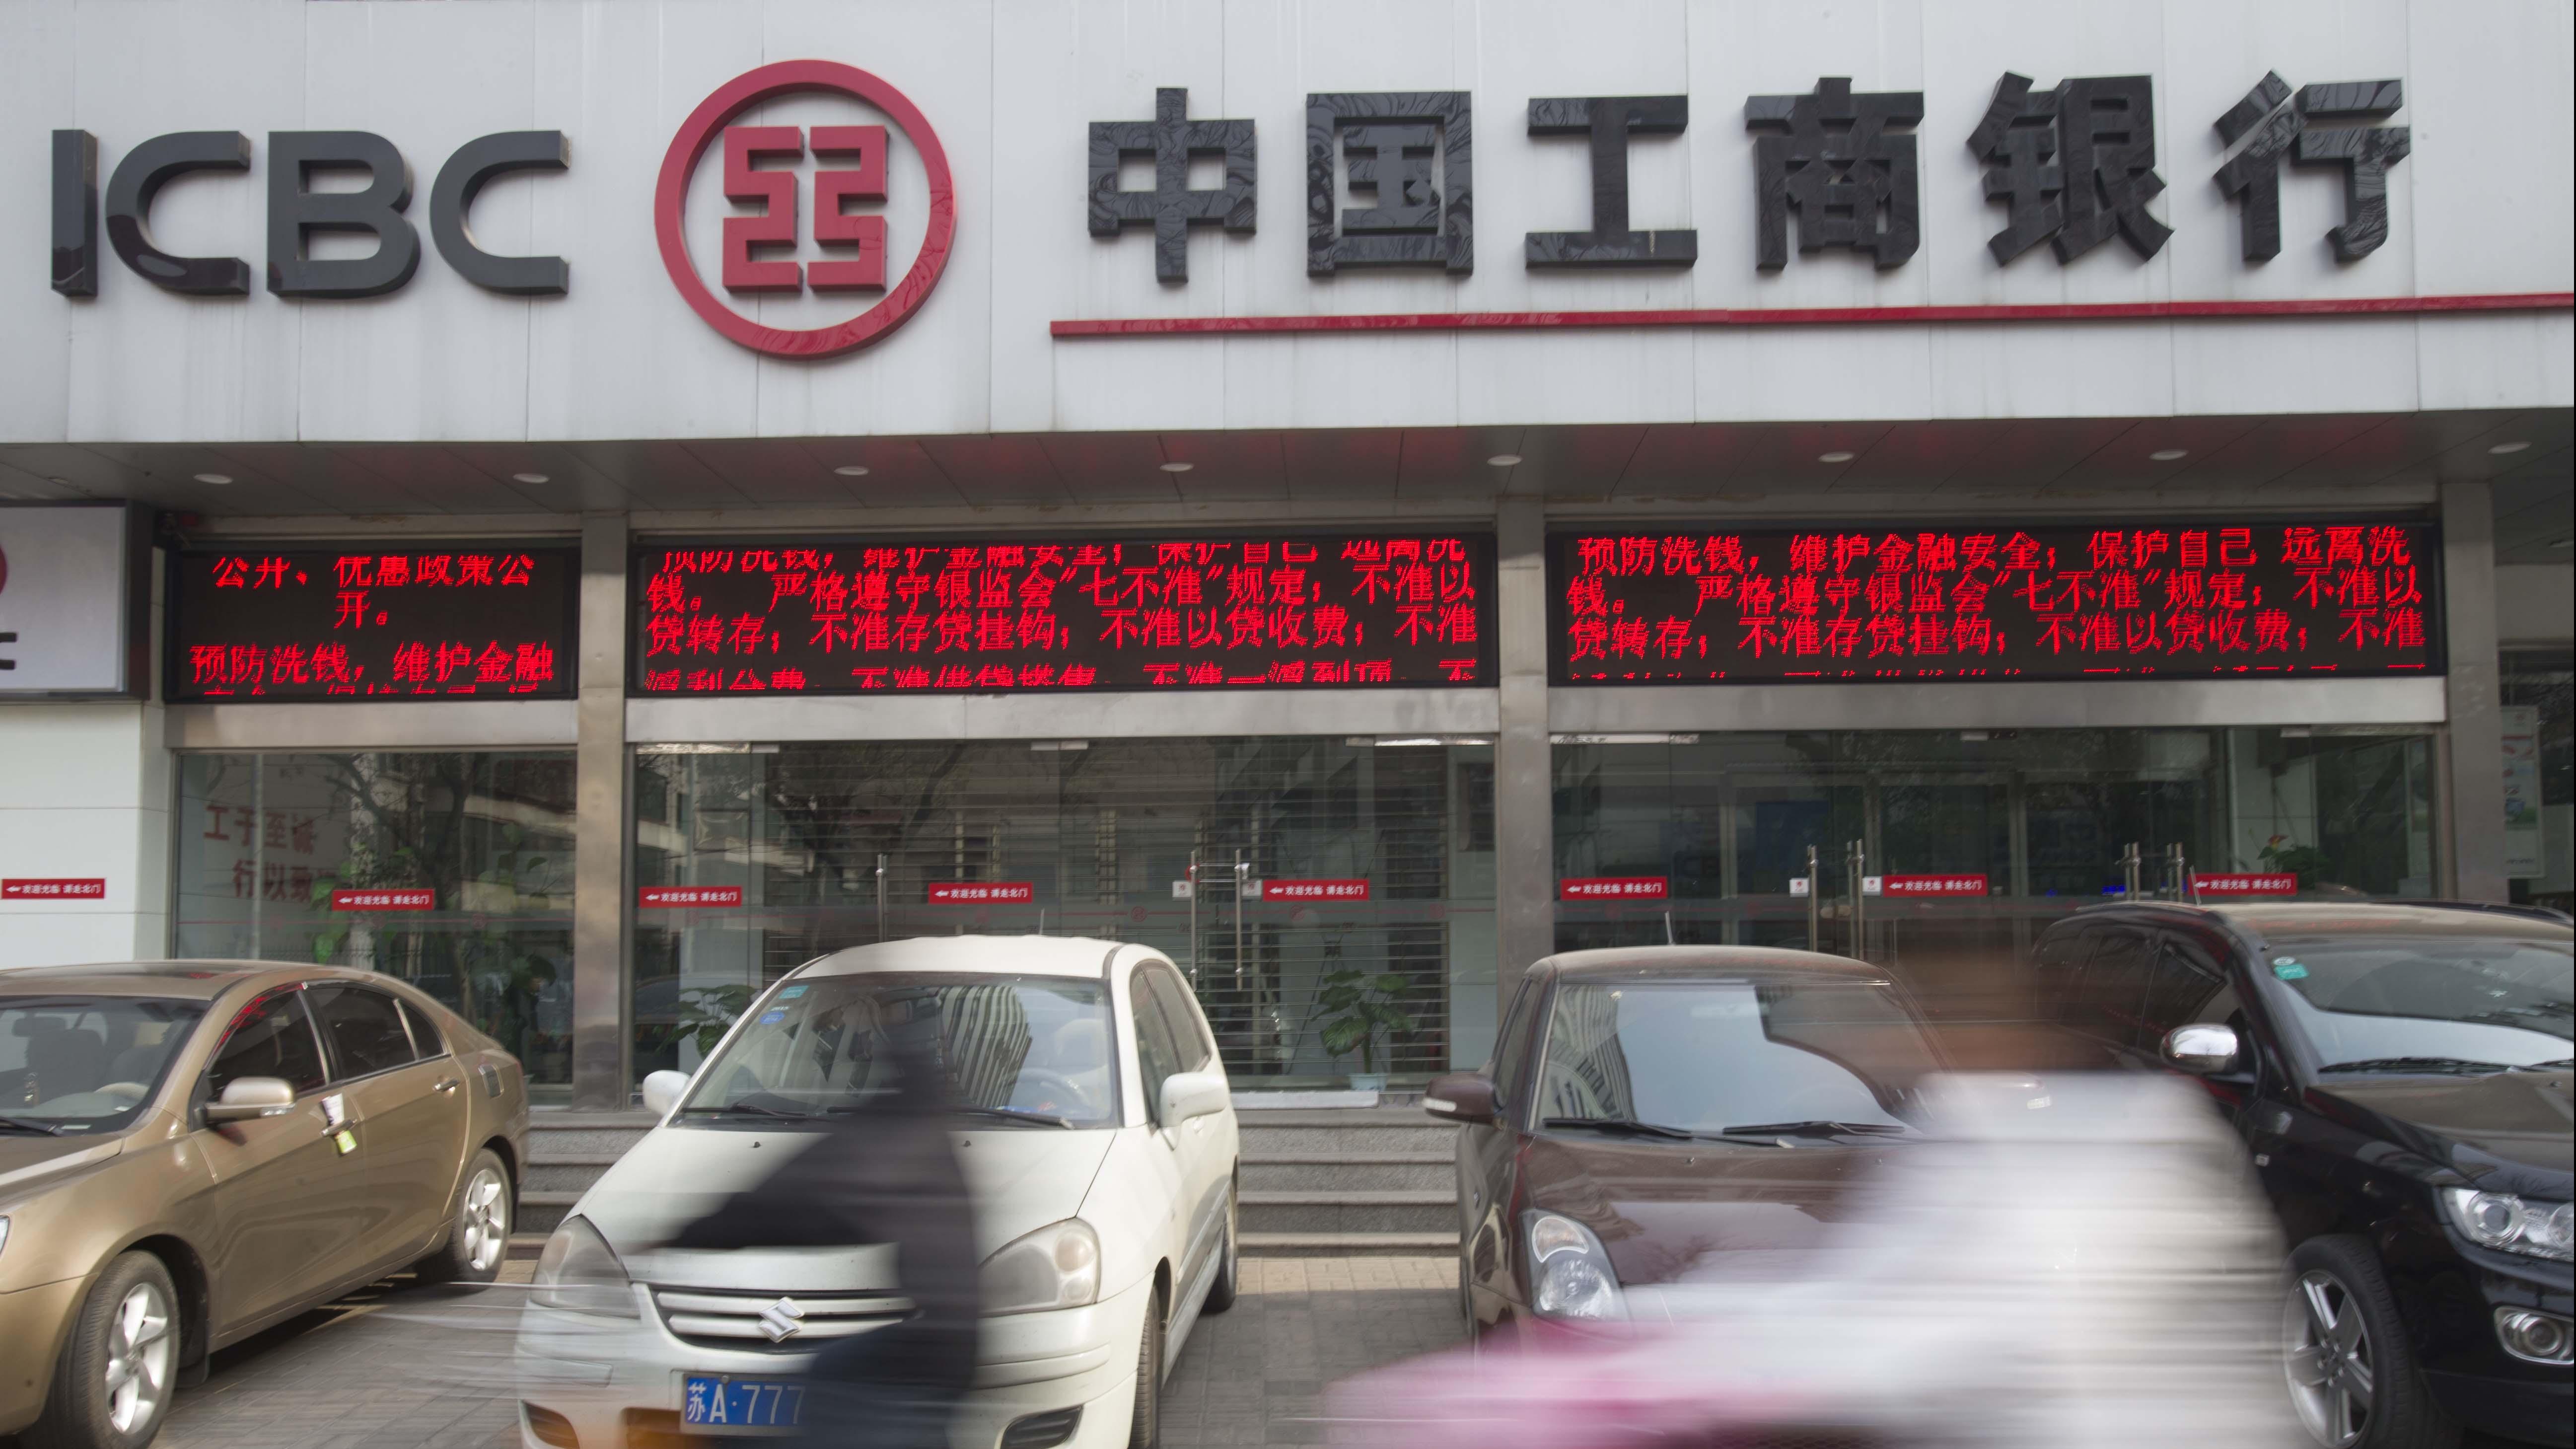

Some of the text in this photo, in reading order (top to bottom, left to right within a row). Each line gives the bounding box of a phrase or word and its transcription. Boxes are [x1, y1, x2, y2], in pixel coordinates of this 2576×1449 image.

[1088, 69, 2411, 284] 中国工商银行
[51, 129, 570, 297] ICBC
[232, 859, 337, 902] 行以致
[1905, 880, 1982, 891] 欢迎光临 请走北门
[2211, 879, 2291, 889] 欢迎光临 请走北门
[22, 884, 101, 893] 欢迎光临 请走北门
[950, 887, 1028, 898] 欢迎光临 请走北门
[1285, 885, 1363, 895] 欢迎光临 请走北门
[1582, 882, 1661, 894] 欢迎光临 请走北门
[354, 895, 429, 905] 欢迎光临 请走北门
[661, 891, 737, 902] 欢迎光临 请走北门
